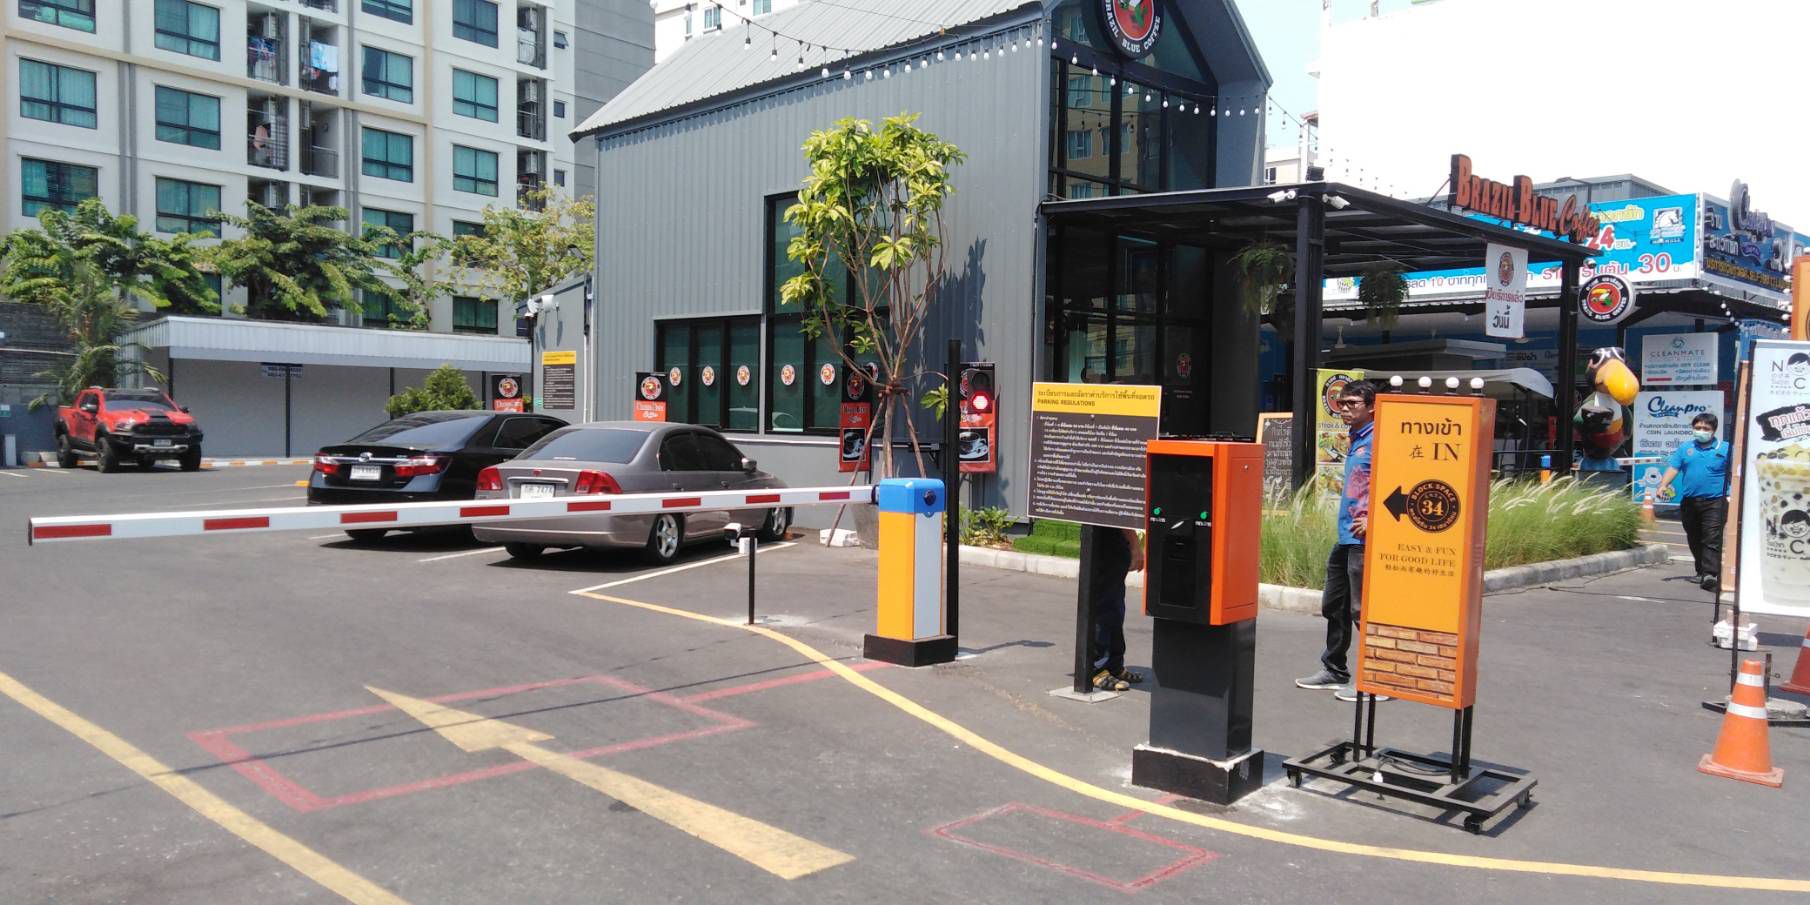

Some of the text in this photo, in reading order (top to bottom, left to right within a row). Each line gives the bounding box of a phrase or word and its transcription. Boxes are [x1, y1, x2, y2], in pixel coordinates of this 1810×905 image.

[1121, 38, 1141, 53] BLUE
[1143, 15, 1161, 50] COFFEE
[1450, 153, 1601, 242] BRAZIL BLUE Coffee
[1639, 252, 1672, 273] 30
[1771, 360, 1784, 372] N
[1793, 377, 1807, 390] C
[1060, 399, 1096, 407] REGULATIONS
[1400, 418, 1462, 436] ทางเข้า
[1431, 442, 1461, 461] IN
[1411, 483, 1457, 502] BLOCK SPACE
[1422, 500, 1444, 516] 34
[1398, 543, 1422, 553] EASY
[1434, 547, 1456, 556] FUN
[1380, 553, 1456, 568] FOR GOOD LIFE
